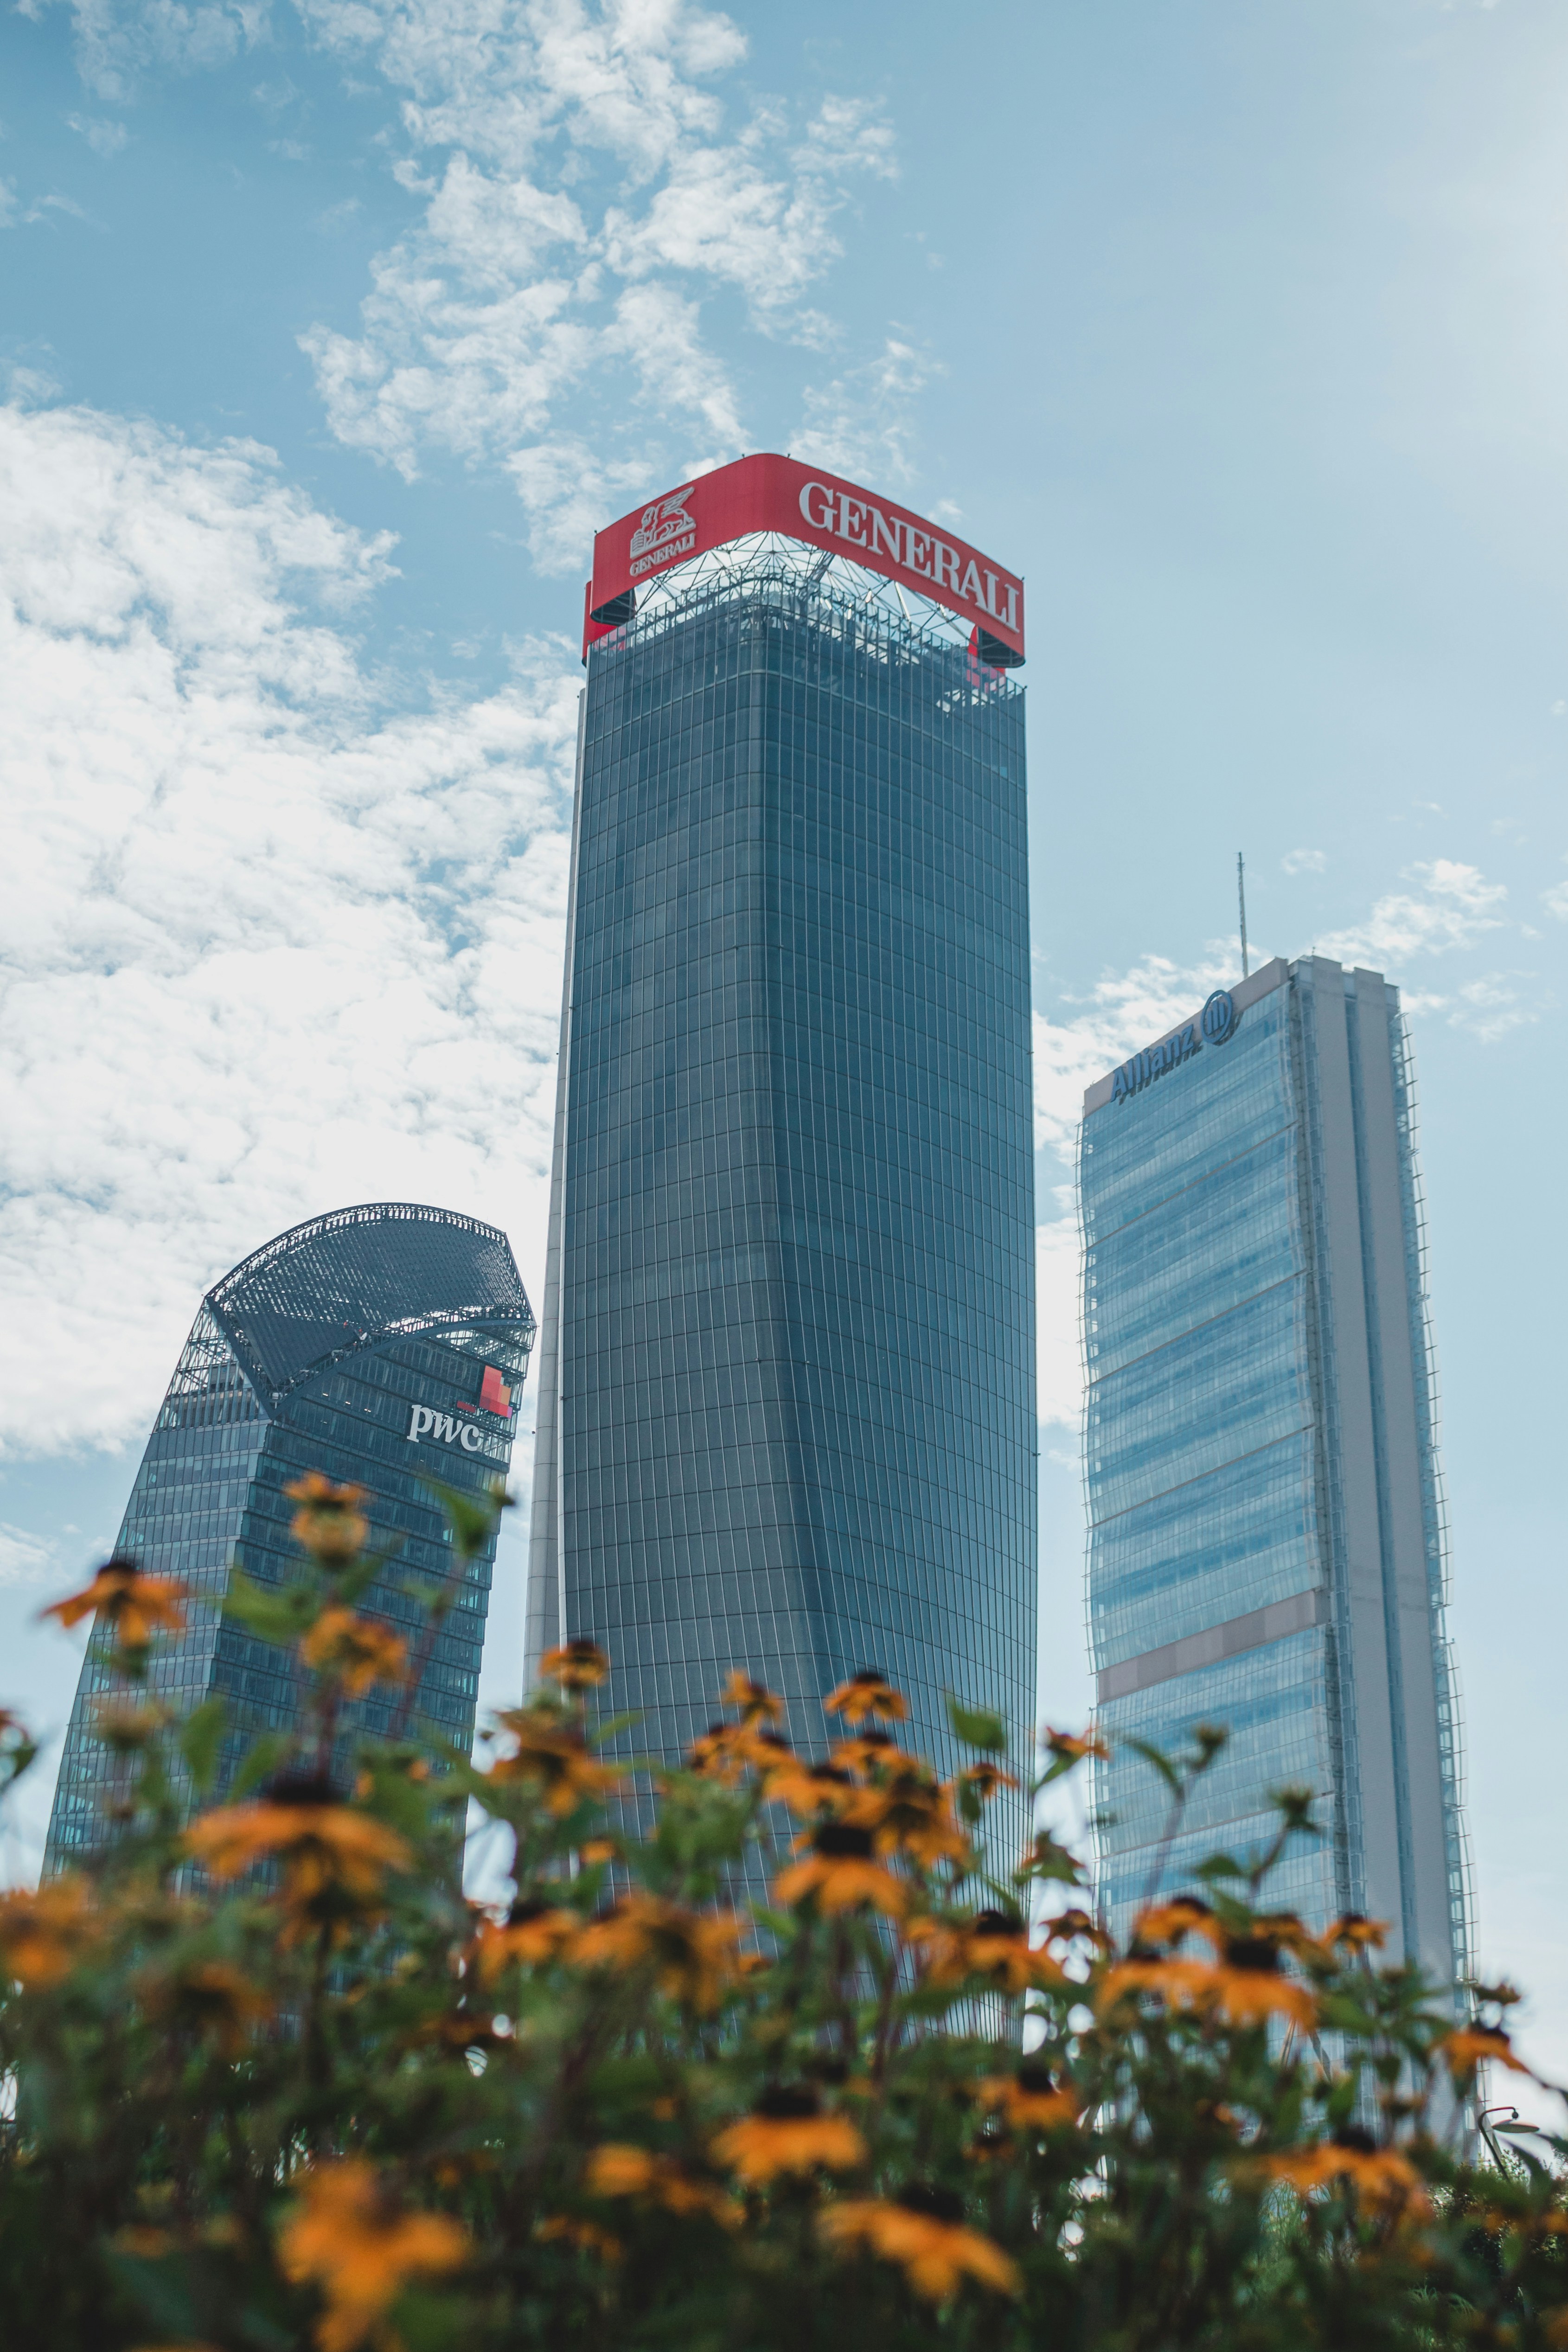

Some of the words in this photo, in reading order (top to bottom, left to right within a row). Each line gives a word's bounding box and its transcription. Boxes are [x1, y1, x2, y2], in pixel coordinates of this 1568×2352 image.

[629, 532, 695, 577] GENERALI
[799, 481, 1020, 634] GENERALI
[1111, 1024, 1194, 1102] Allianz
[407, 1404, 479, 1451] pwc
